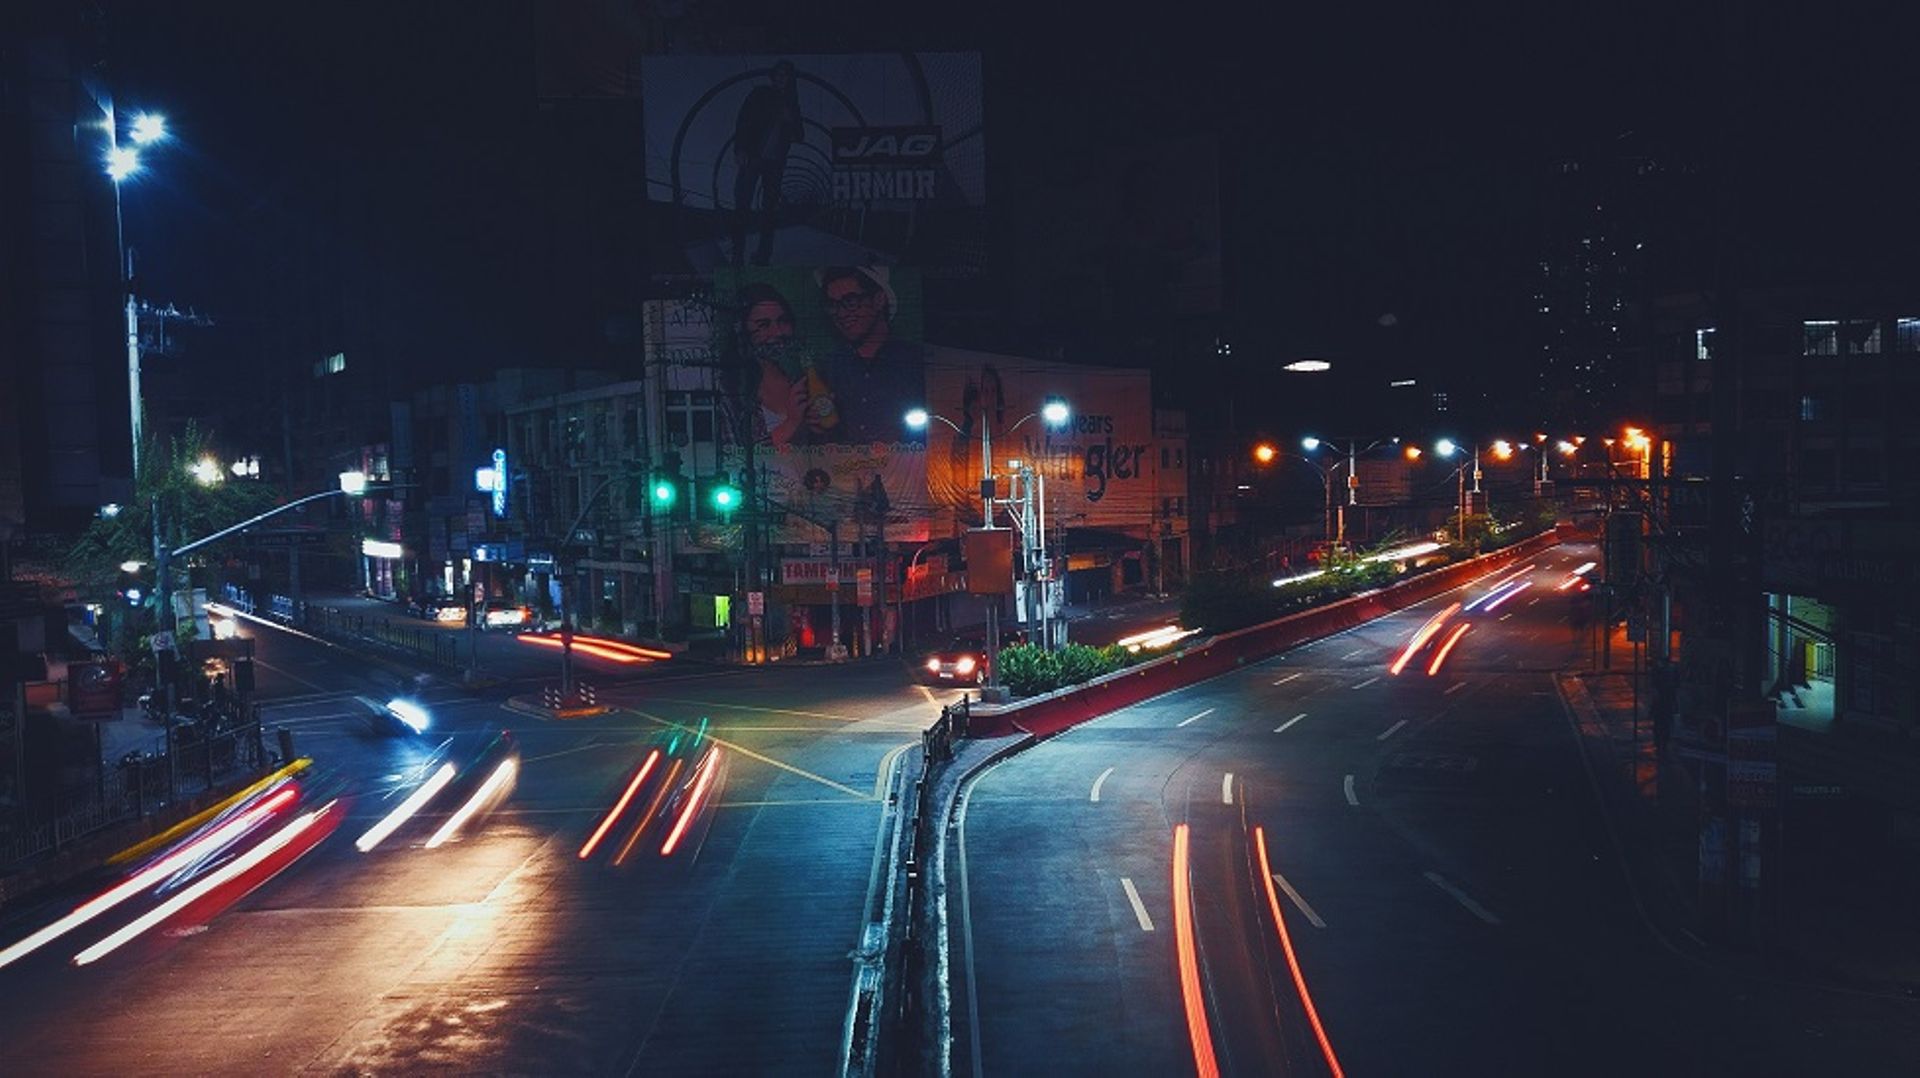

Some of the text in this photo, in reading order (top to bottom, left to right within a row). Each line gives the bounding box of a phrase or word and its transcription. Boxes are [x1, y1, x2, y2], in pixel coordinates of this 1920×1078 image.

[835, 133, 938, 158] JAG
[832, 169, 936, 201] ARMOR
[1024, 435, 1151, 502] Wrangler
